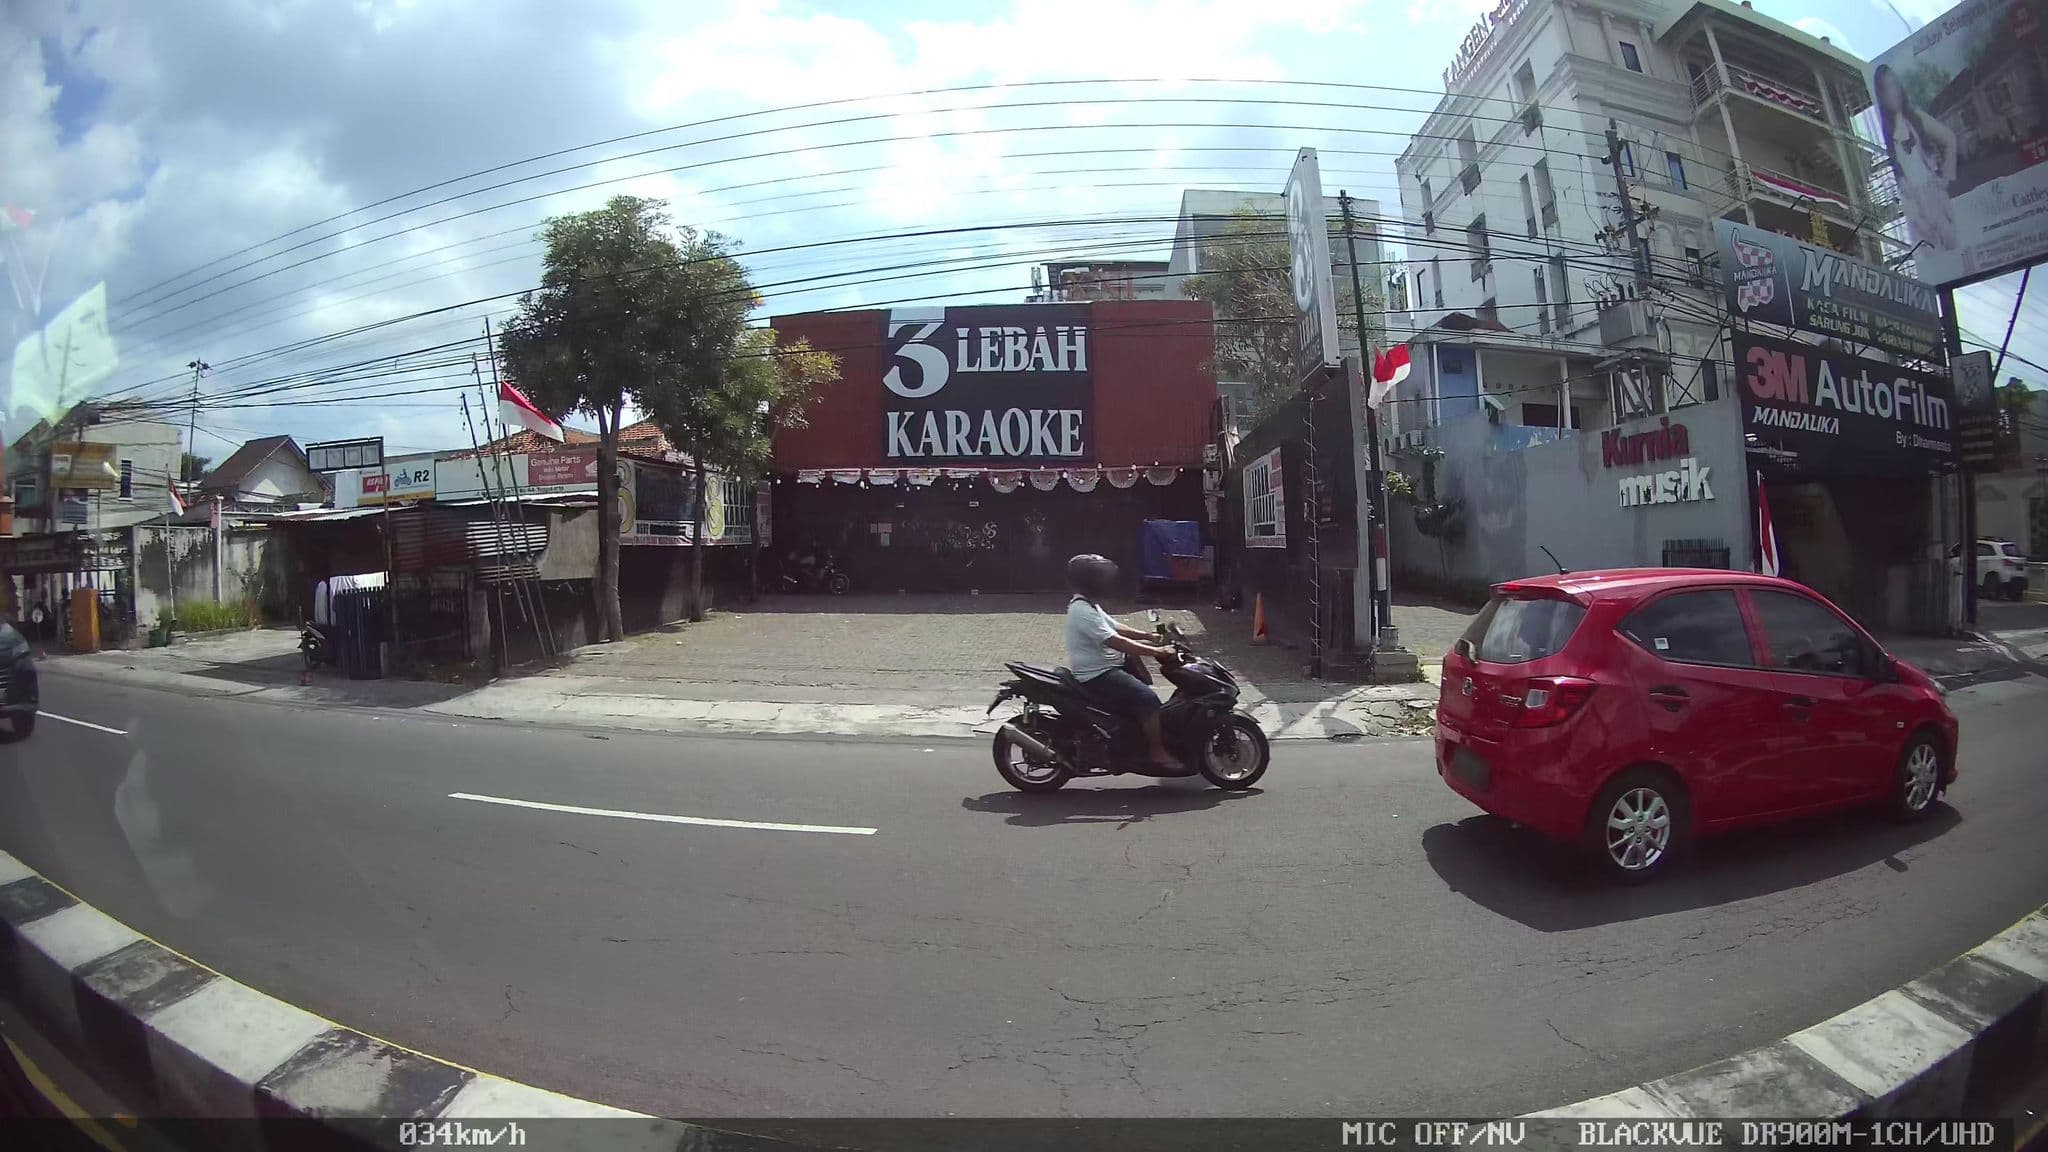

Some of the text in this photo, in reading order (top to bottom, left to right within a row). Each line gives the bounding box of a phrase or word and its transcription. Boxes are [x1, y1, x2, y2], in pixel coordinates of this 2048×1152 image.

[1799, 246, 1936, 313] MANDALIKA
[1809, 313, 1851, 335] SARUNG
[1852, 324, 1871, 340] JOK
[1842, 305, 1869, 324] FILM
[882, 307, 1088, 399] 3 LEBAH
[1746, 346, 1950, 430] 3M AutoFilm
[886, 407, 1085, 457] KARAOKE
[1752, 405, 1840, 435] MANDALIKA
[1896, 430, 1907, 448] By
[530, 456, 582, 467] Genuine Parts
[1601, 416, 1690, 468] Kurnia
[413, 469, 431, 484] R2
[1619, 457, 1715, 507] musik
